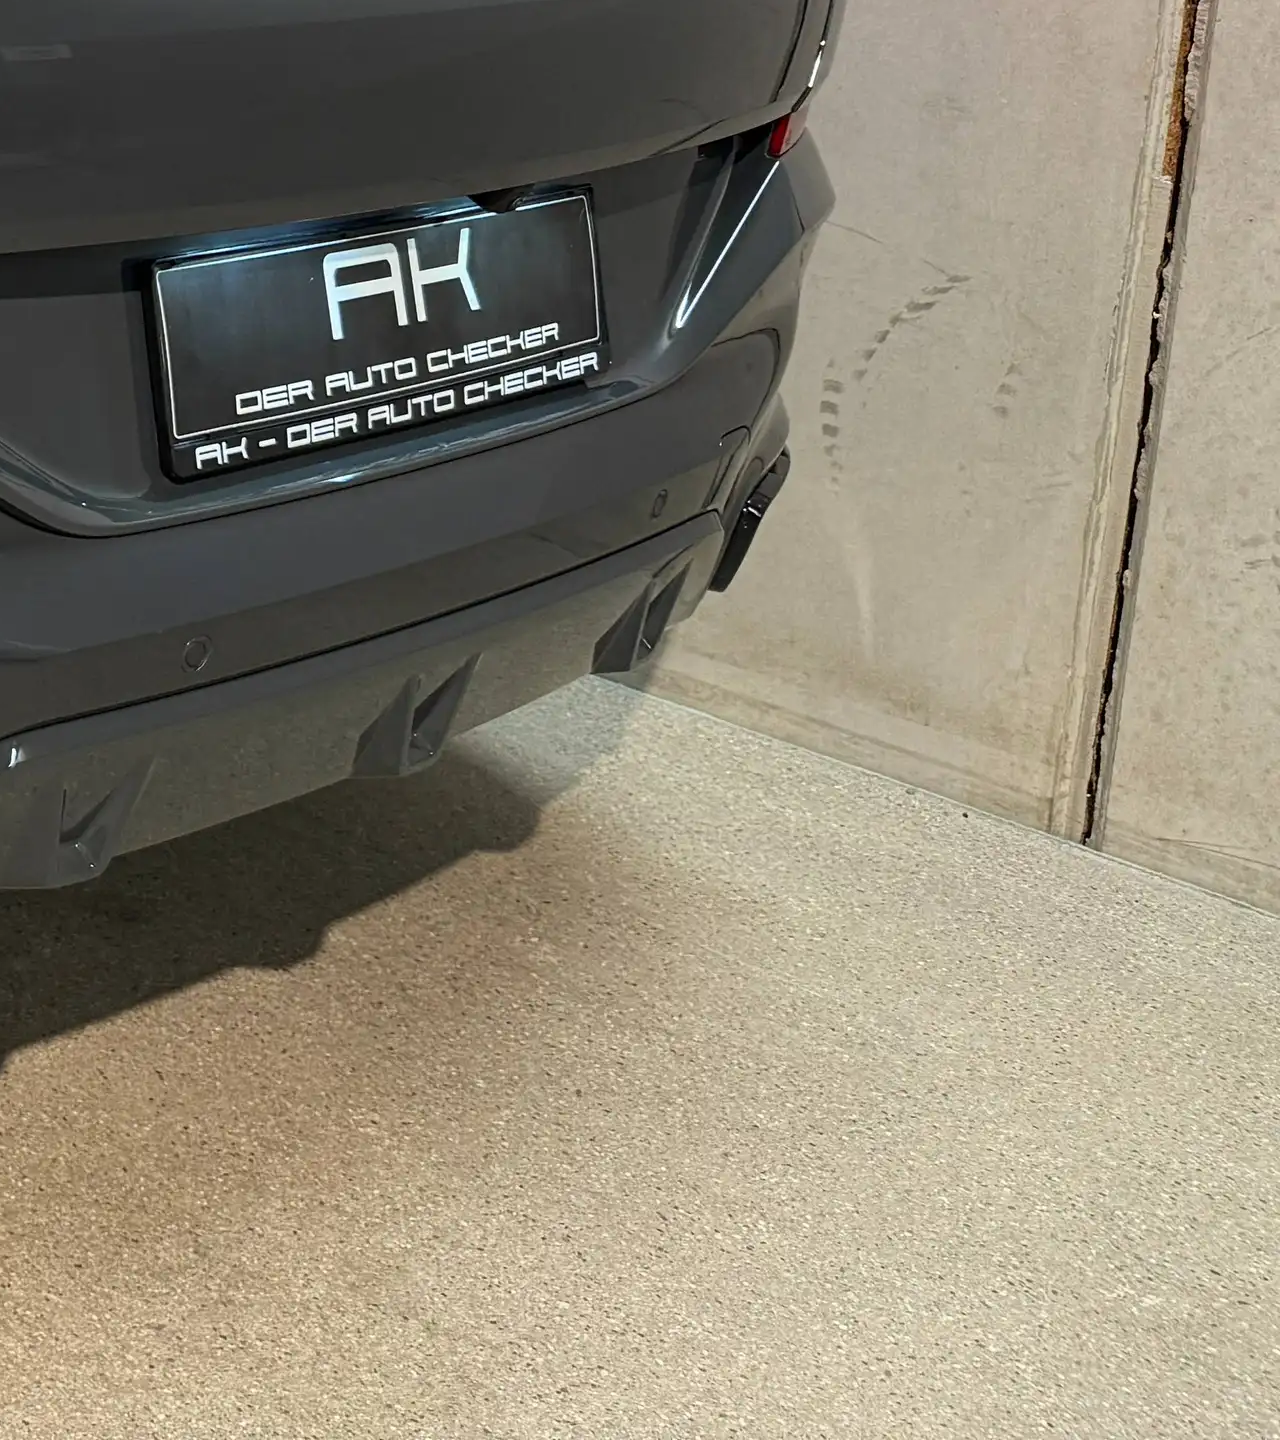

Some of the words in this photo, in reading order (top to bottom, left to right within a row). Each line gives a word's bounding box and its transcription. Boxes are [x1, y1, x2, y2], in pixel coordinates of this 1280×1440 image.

[322, 227, 481, 340] AK
[195, 436, 249, 470] AK
[287, 412, 358, 449] DER
[367, 390, 456, 430] AUTO
[463, 351, 600, 408] CHECKER
[236, 380, 315, 416] DER
[326, 357, 418, 397] AUTO
[427, 322, 560, 374] CHECKER
